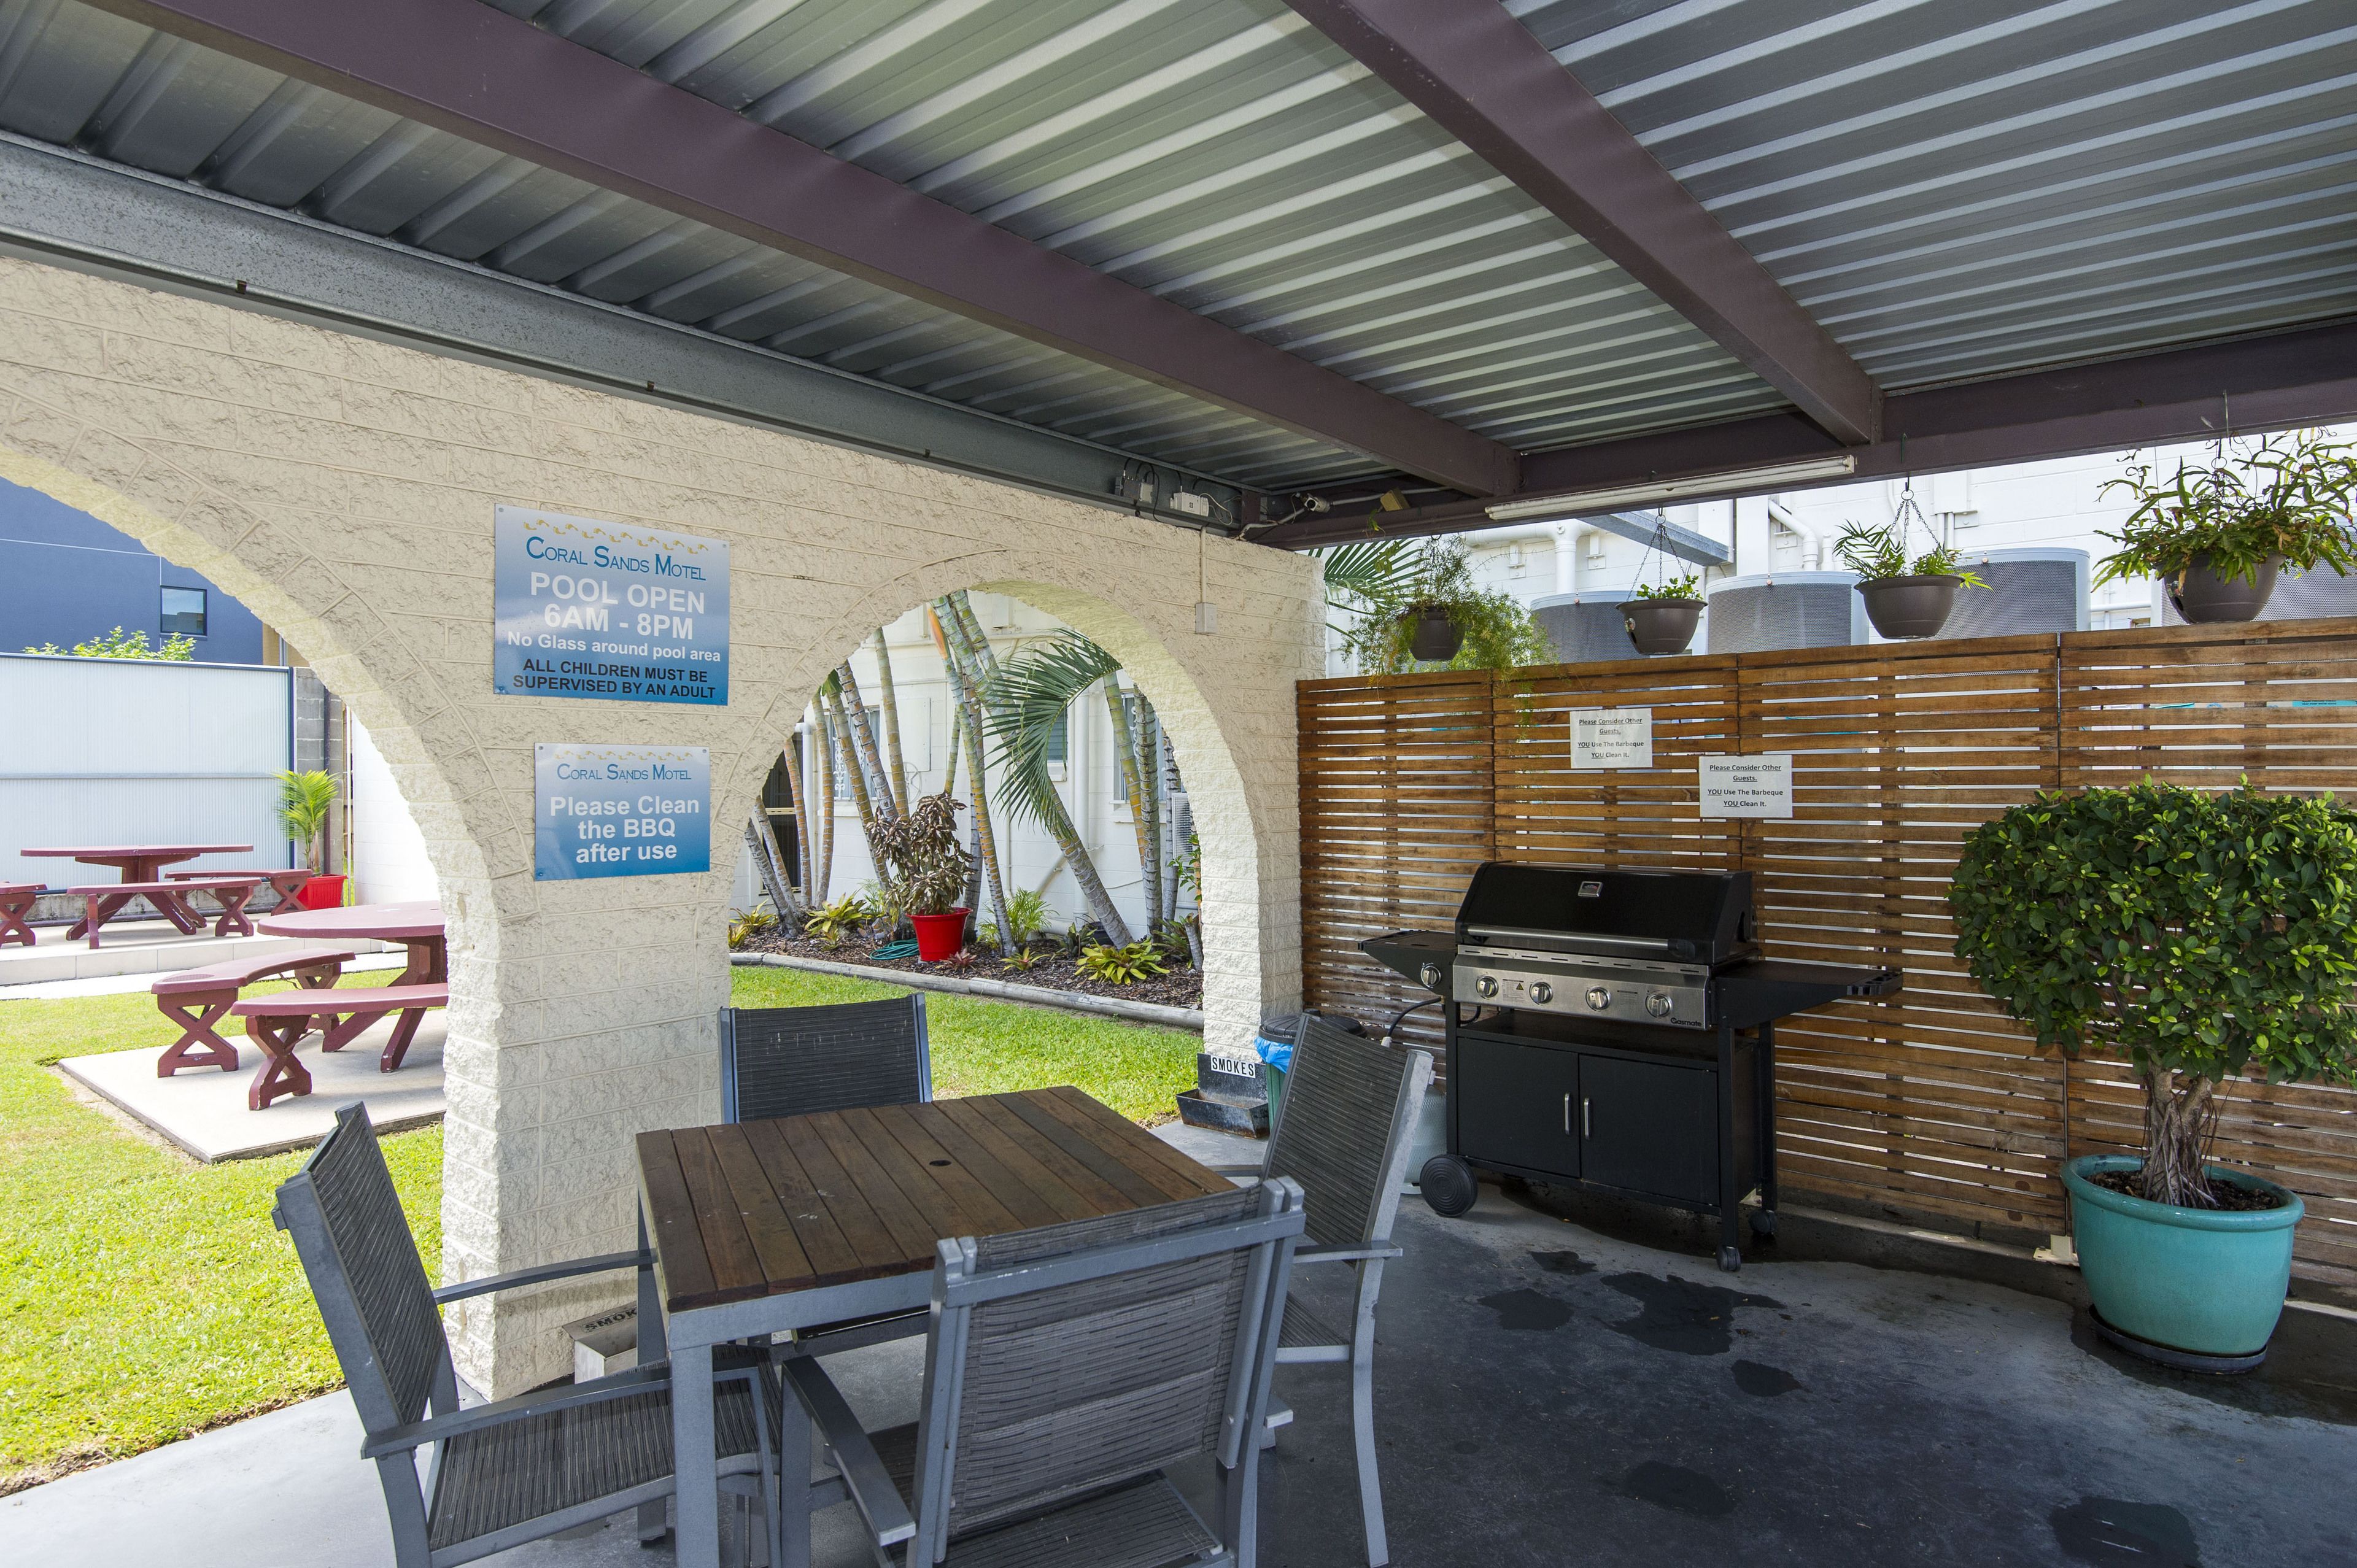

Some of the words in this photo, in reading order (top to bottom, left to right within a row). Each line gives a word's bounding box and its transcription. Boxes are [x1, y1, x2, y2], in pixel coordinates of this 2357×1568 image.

[531, 572, 618, 604] POOL
[627, 584, 705, 614] OPEN
[544, 603, 608, 632] 6AM
[637, 613, 692, 640] 8PM
[508, 631, 532, 647] No
[538, 634, 586, 651] Glass
[592, 640, 648, 658] around
[653, 644, 685, 660] pool
[691, 649, 720, 662] area
[523, 659, 555, 673] ALL
[560, 661, 640, 678] CHILDREN
[644, 667, 684, 681] MUST
[689, 670, 707, 682] BE
[513, 676, 617, 693] SUPERVISED
[622, 682, 642, 694] BY
[646, 683, 666, 695] AN
[670, 685, 715, 698] ADULT
[551, 797, 630, 816] Please
[638, 795, 699, 814] Clean
[578, 820, 616, 839] the
[624, 818, 675, 838] BBQ
[576, 843, 630, 863] after
[638, 844, 676, 860] use
[1212, 1057, 1254, 1076] SMOKES
[585, 1308, 637, 1330] SMOK
